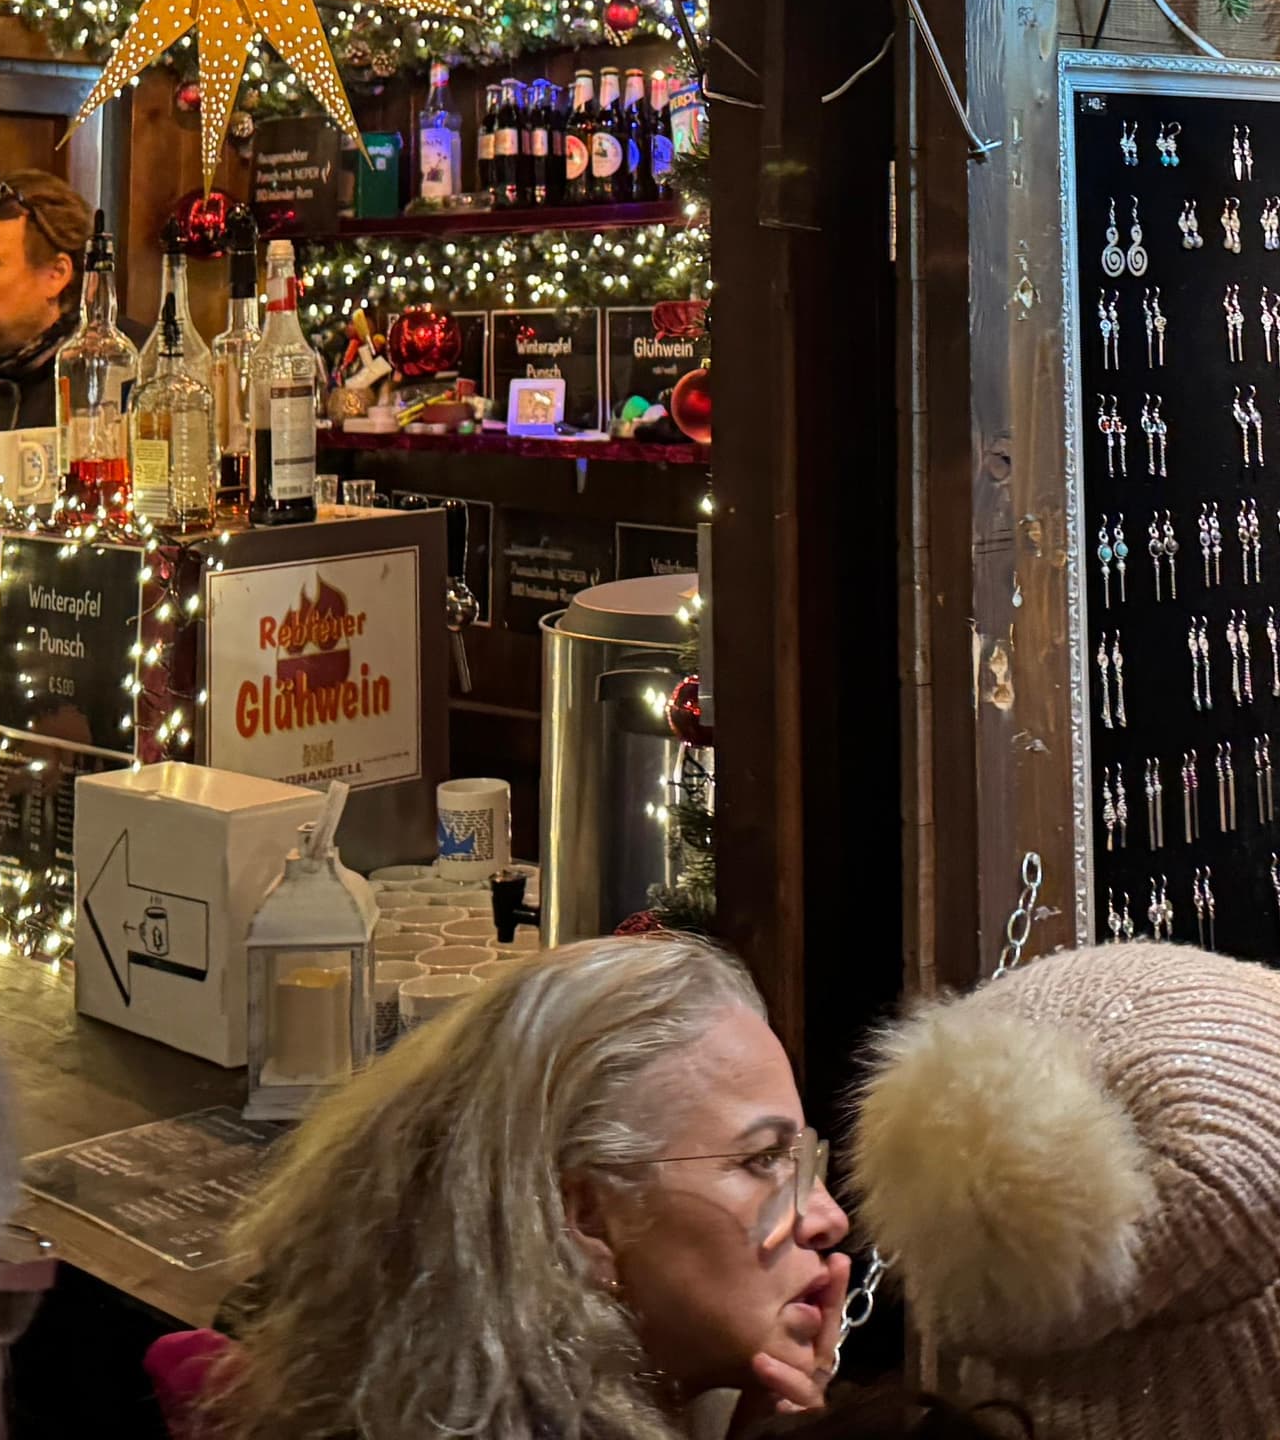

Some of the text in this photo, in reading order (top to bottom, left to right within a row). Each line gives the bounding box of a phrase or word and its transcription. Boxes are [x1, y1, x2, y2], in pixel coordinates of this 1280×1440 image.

[515, 336, 572, 358] Winterapfel
[633, 336, 694, 359] Glühwein
[526, 362, 562, 379] Punsch
[28, 583, 102, 622] Winterapfel
[39, 627, 85, 659] Punsch
[259, 611, 367, 651] Rebfeuer
[235, 662, 392, 739] Glühwein
[272, 761, 363, 786] ORANDELL
